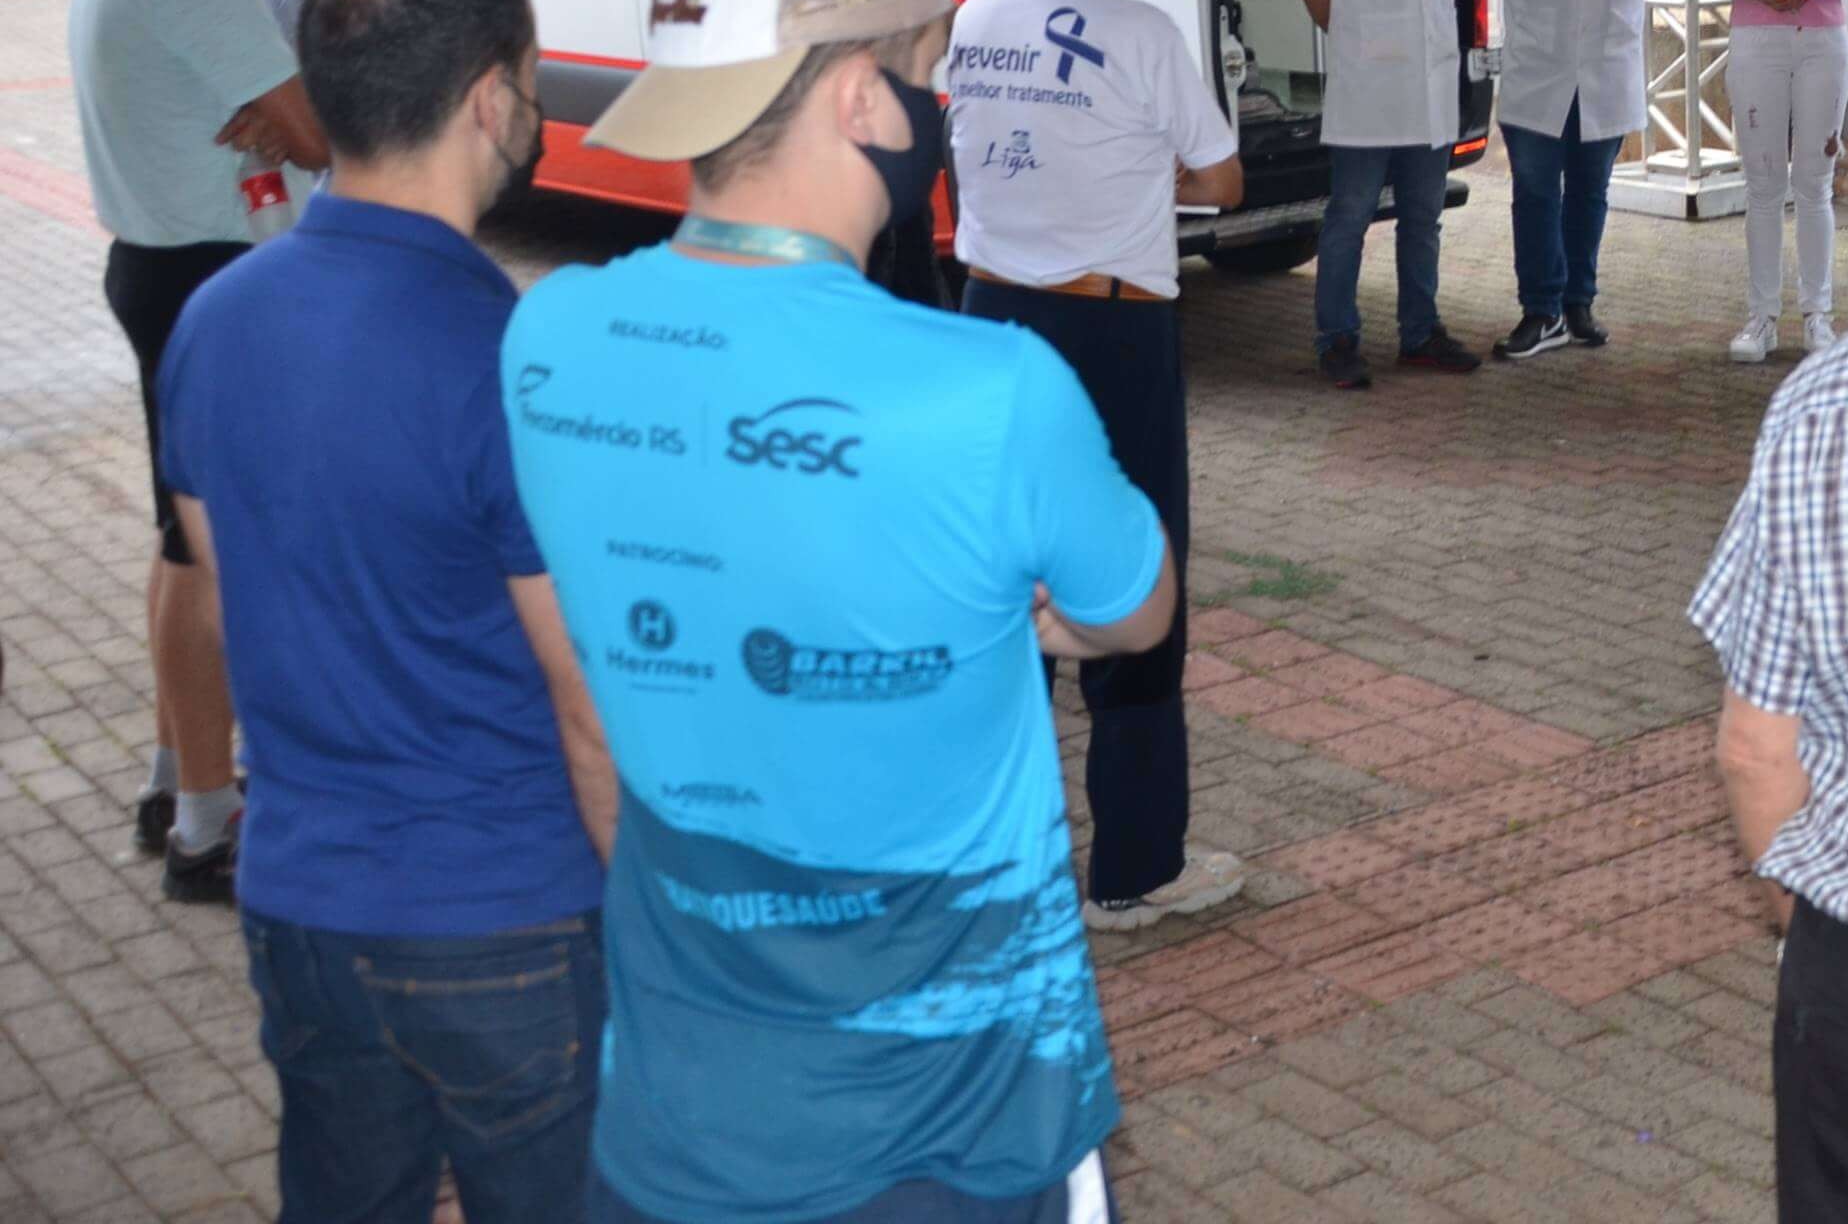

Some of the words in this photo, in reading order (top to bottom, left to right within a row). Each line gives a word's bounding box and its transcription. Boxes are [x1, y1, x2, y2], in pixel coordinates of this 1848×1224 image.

[1007, 83, 1093, 108] tratamento
[981, 140, 1044, 179] Liga
[725, 414, 864, 478] Sesc
[605, 647, 714, 679] Hermes
